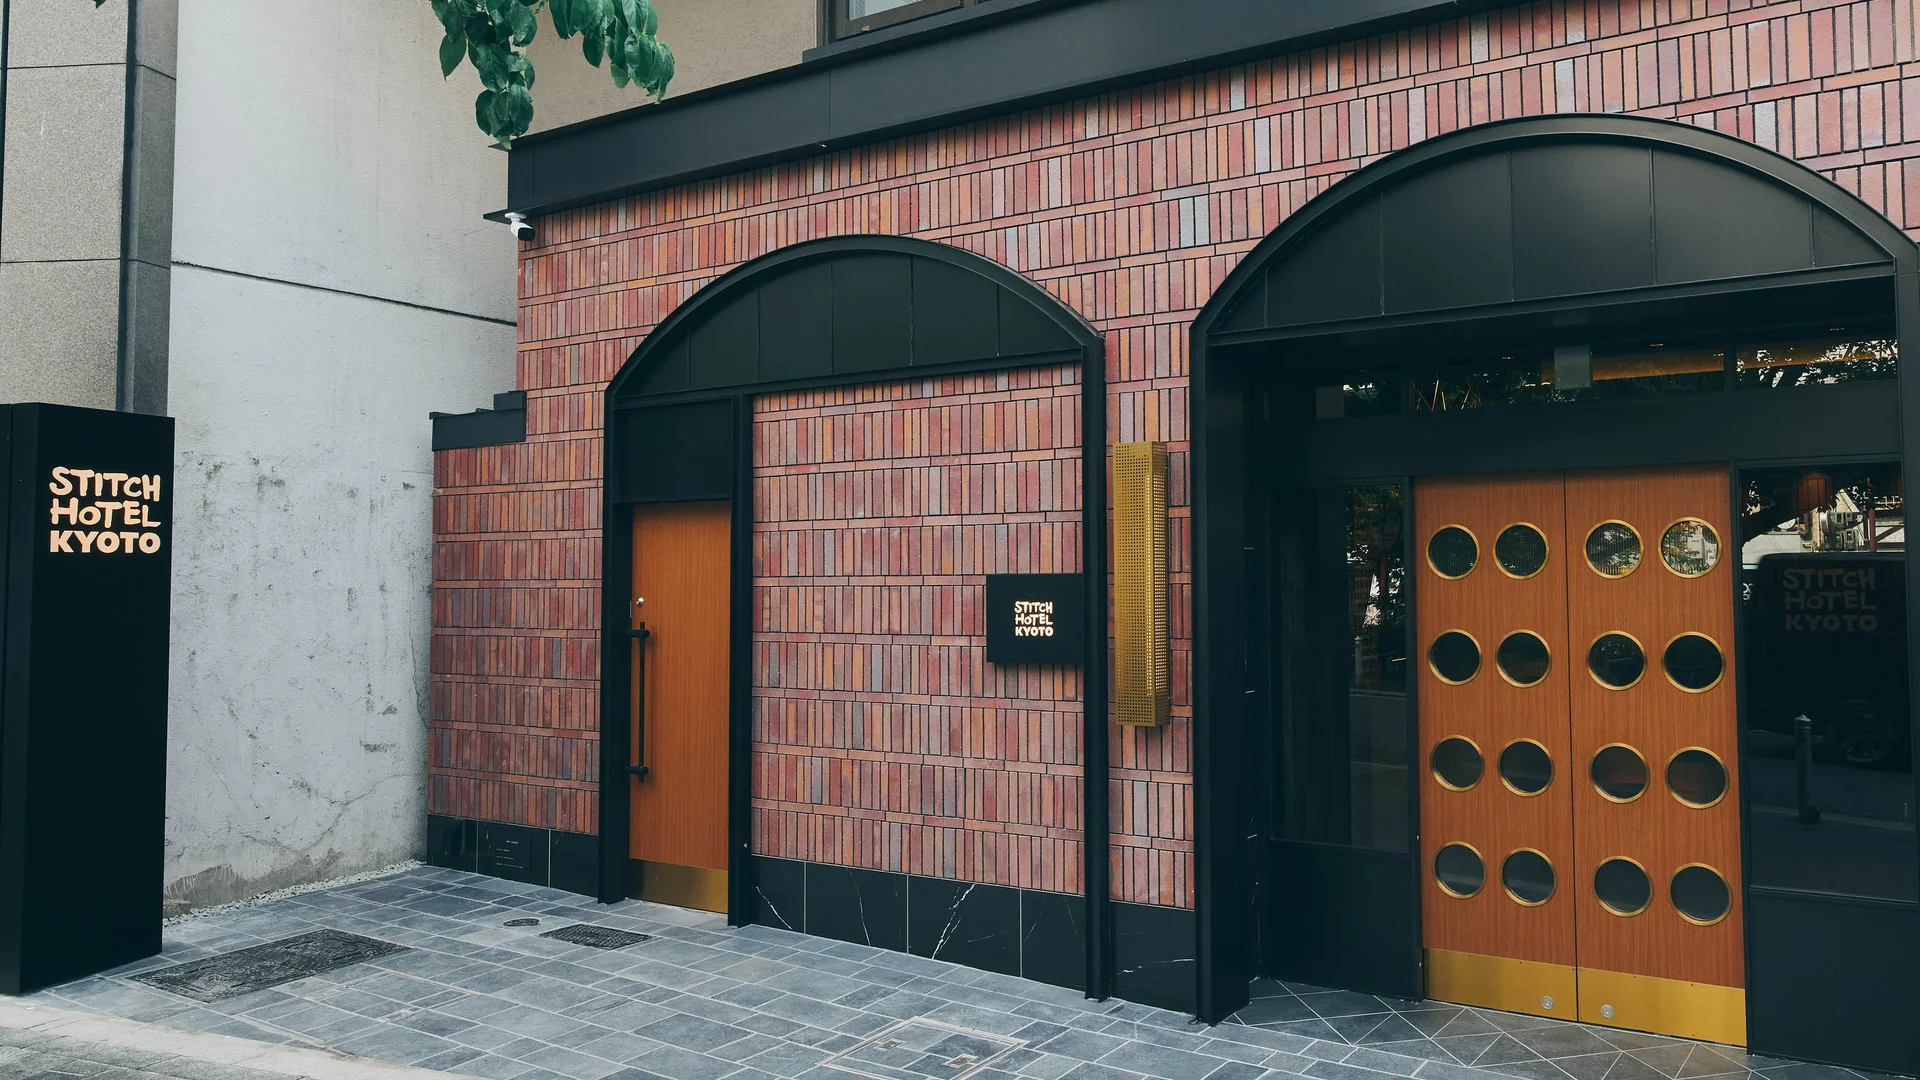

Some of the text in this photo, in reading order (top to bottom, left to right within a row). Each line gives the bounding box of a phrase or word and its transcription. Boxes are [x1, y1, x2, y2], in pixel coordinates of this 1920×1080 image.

[49, 466, 161, 502] STITCH
[49, 530, 161, 554] KYOTO
[1782, 568, 1876, 590] STITCH
[1014, 601, 1053, 614] STITCH
[1015, 626, 1054, 637] KYOTO
[1785, 614, 1878, 632] KYOTO
